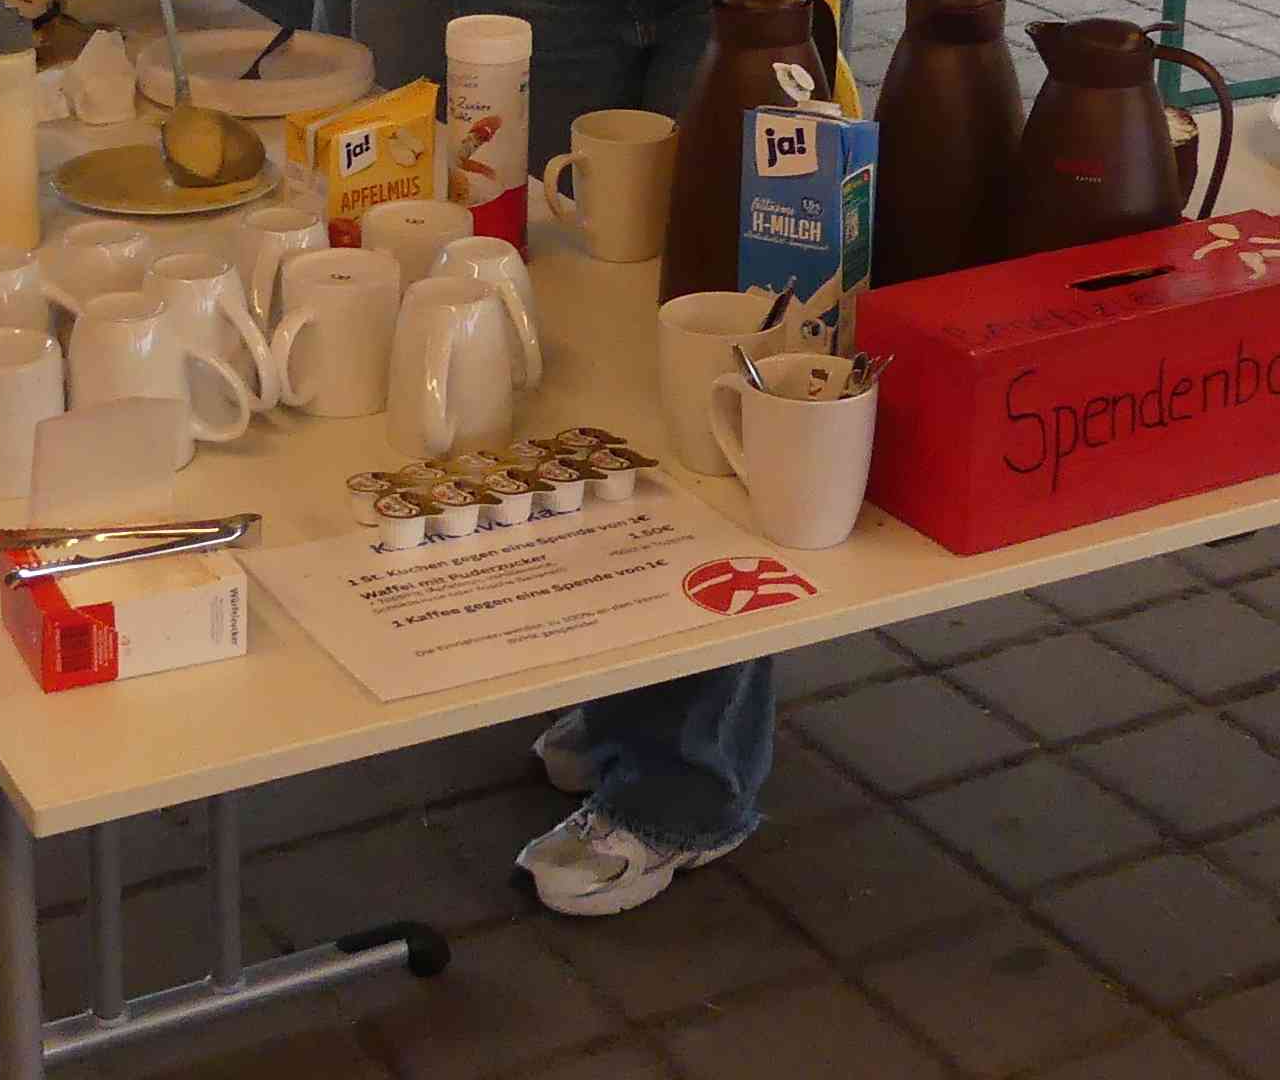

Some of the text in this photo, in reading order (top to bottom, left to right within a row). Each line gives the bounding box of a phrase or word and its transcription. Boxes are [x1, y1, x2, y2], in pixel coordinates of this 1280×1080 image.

[345, 134, 371, 169] ja!
[765, 127, 807, 168] ja!
[341, 176, 421, 213] APFELMUS
[752, 210, 822, 242] H-MILCH
[386, 558, 448, 578] Kuchen
[451, 548, 501, 567] gegen
[535, 525, 597, 545] Spende
[359, 580, 417, 600] Waffel
[447, 553, 548, 581] Puderzucker
[404, 605, 461, 624] Kaffee
[463, 595, 513, 614] gegen
[515, 587, 551, 602] eine
[551, 570, 614, 593] Spende
